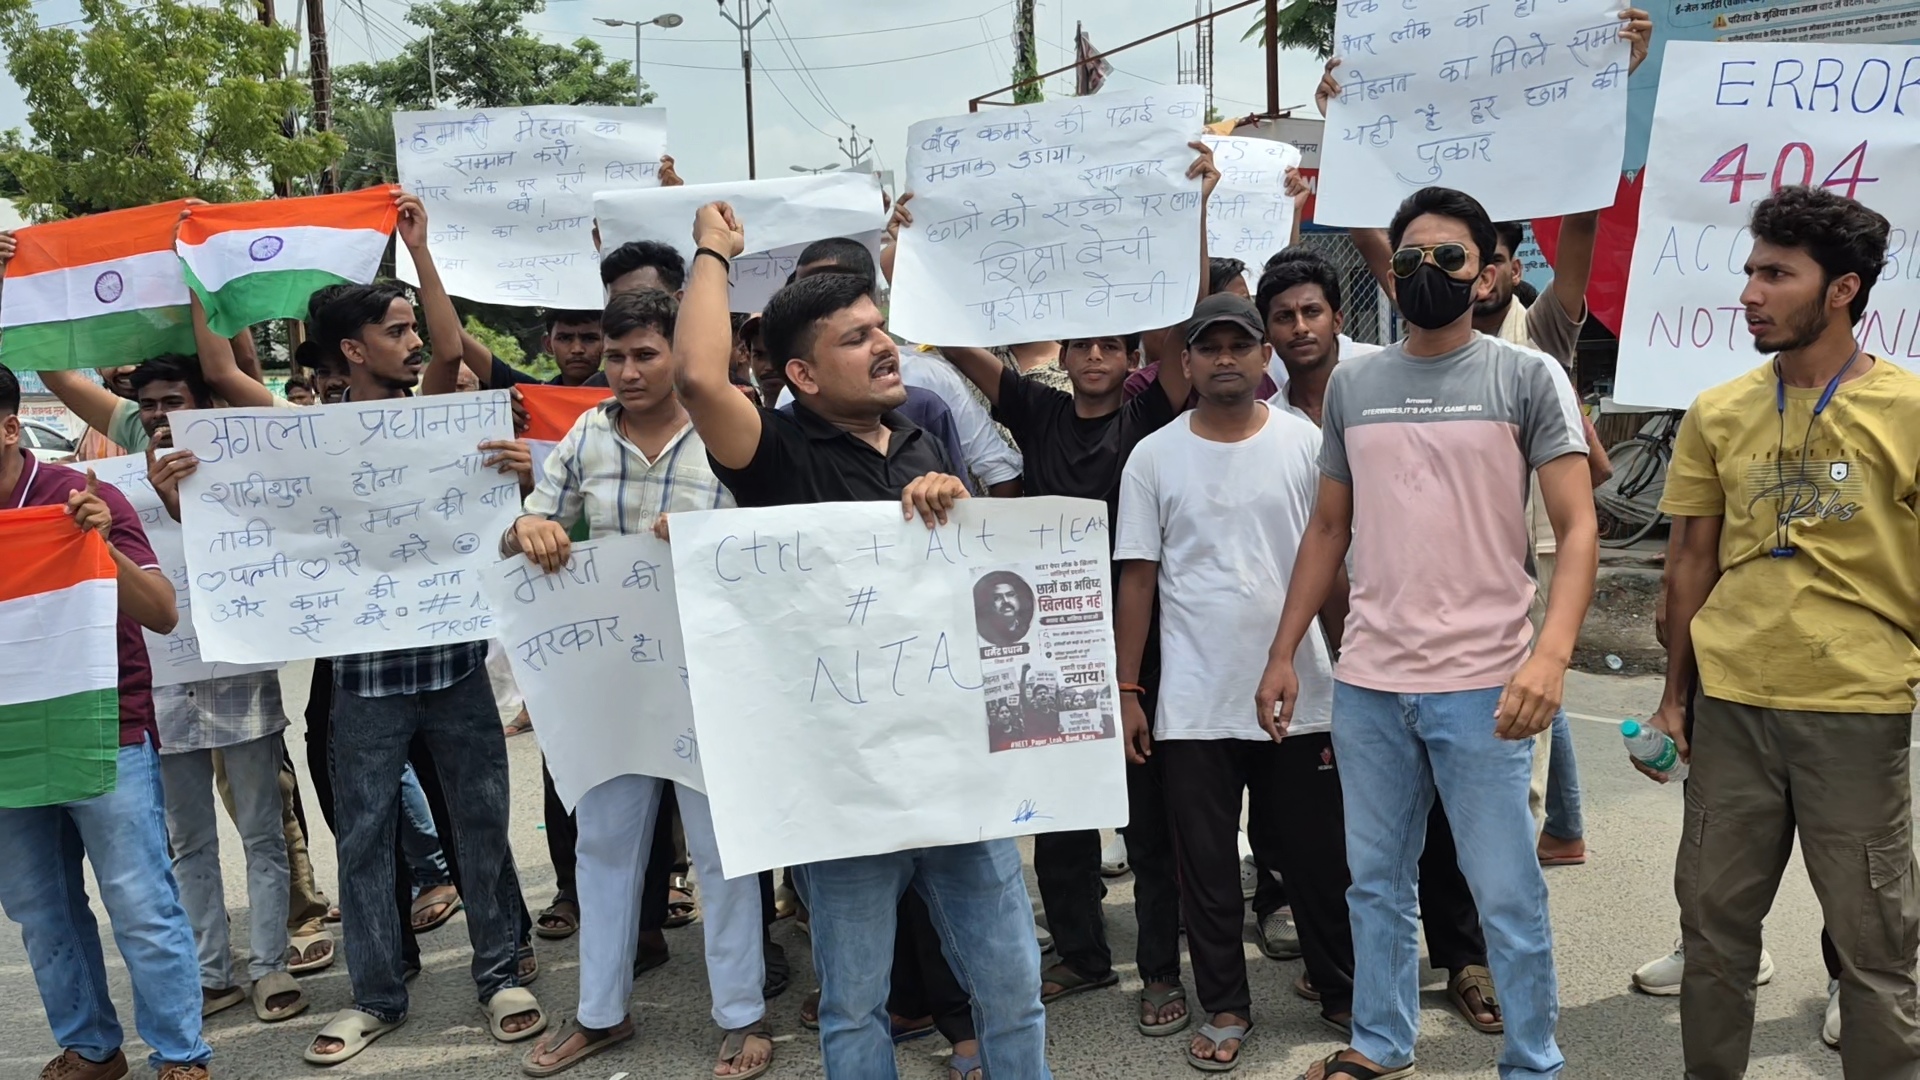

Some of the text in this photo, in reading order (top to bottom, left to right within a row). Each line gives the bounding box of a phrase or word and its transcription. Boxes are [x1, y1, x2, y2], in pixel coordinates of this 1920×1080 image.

[1389, 19, 1431, 44] लीक
[1454, 4, 1489, 29] का
[1728, 14, 1752, 24] परिवार
[1753, 11, 1761, 21] के
[1762, 7, 1788, 22] मुखिया
[1790, 6, 1800, 15] का
[1340, 70, 1417, 105] मेहनत
[1439, 56, 1478, 83] का
[1491, 32, 1555, 77] मिले
[1055, 105, 1092, 135] की
[1343, 115, 1398, 148] यही
[1524, 78, 1574, 107] छात्र
[1592, 62, 1628, 89] की
[410, 111, 494, 151] हमारी
[515, 110, 584, 142] मेहनत
[1396, 132, 1496, 186] पुकार
[516, 178, 538, 193] पर
[990, 192, 1037, 232] को
[1134, 193, 1166, 217] पर
[973, 240, 1068, 289] शिक्षा
[965, 285, 1073, 331] परीक्षा
[1648, 306, 1747, 351] NOT
[357, 390, 513, 446] प्रधानमंत्री
[433, 487, 468, 520] की
[480, 481, 519, 508] बात
[715, 530, 812, 582] Ctrl
[926, 519, 995, 563] Alt
[289, 588, 345, 611] काम
[366, 574, 400, 600] की
[622, 560, 661, 592] की
[1036, 579, 1058, 595] छात्रों
[1059, 580, 1072, 592] का
[517, 615, 624, 672] सरकार
[810, 631, 984, 705] NTA
